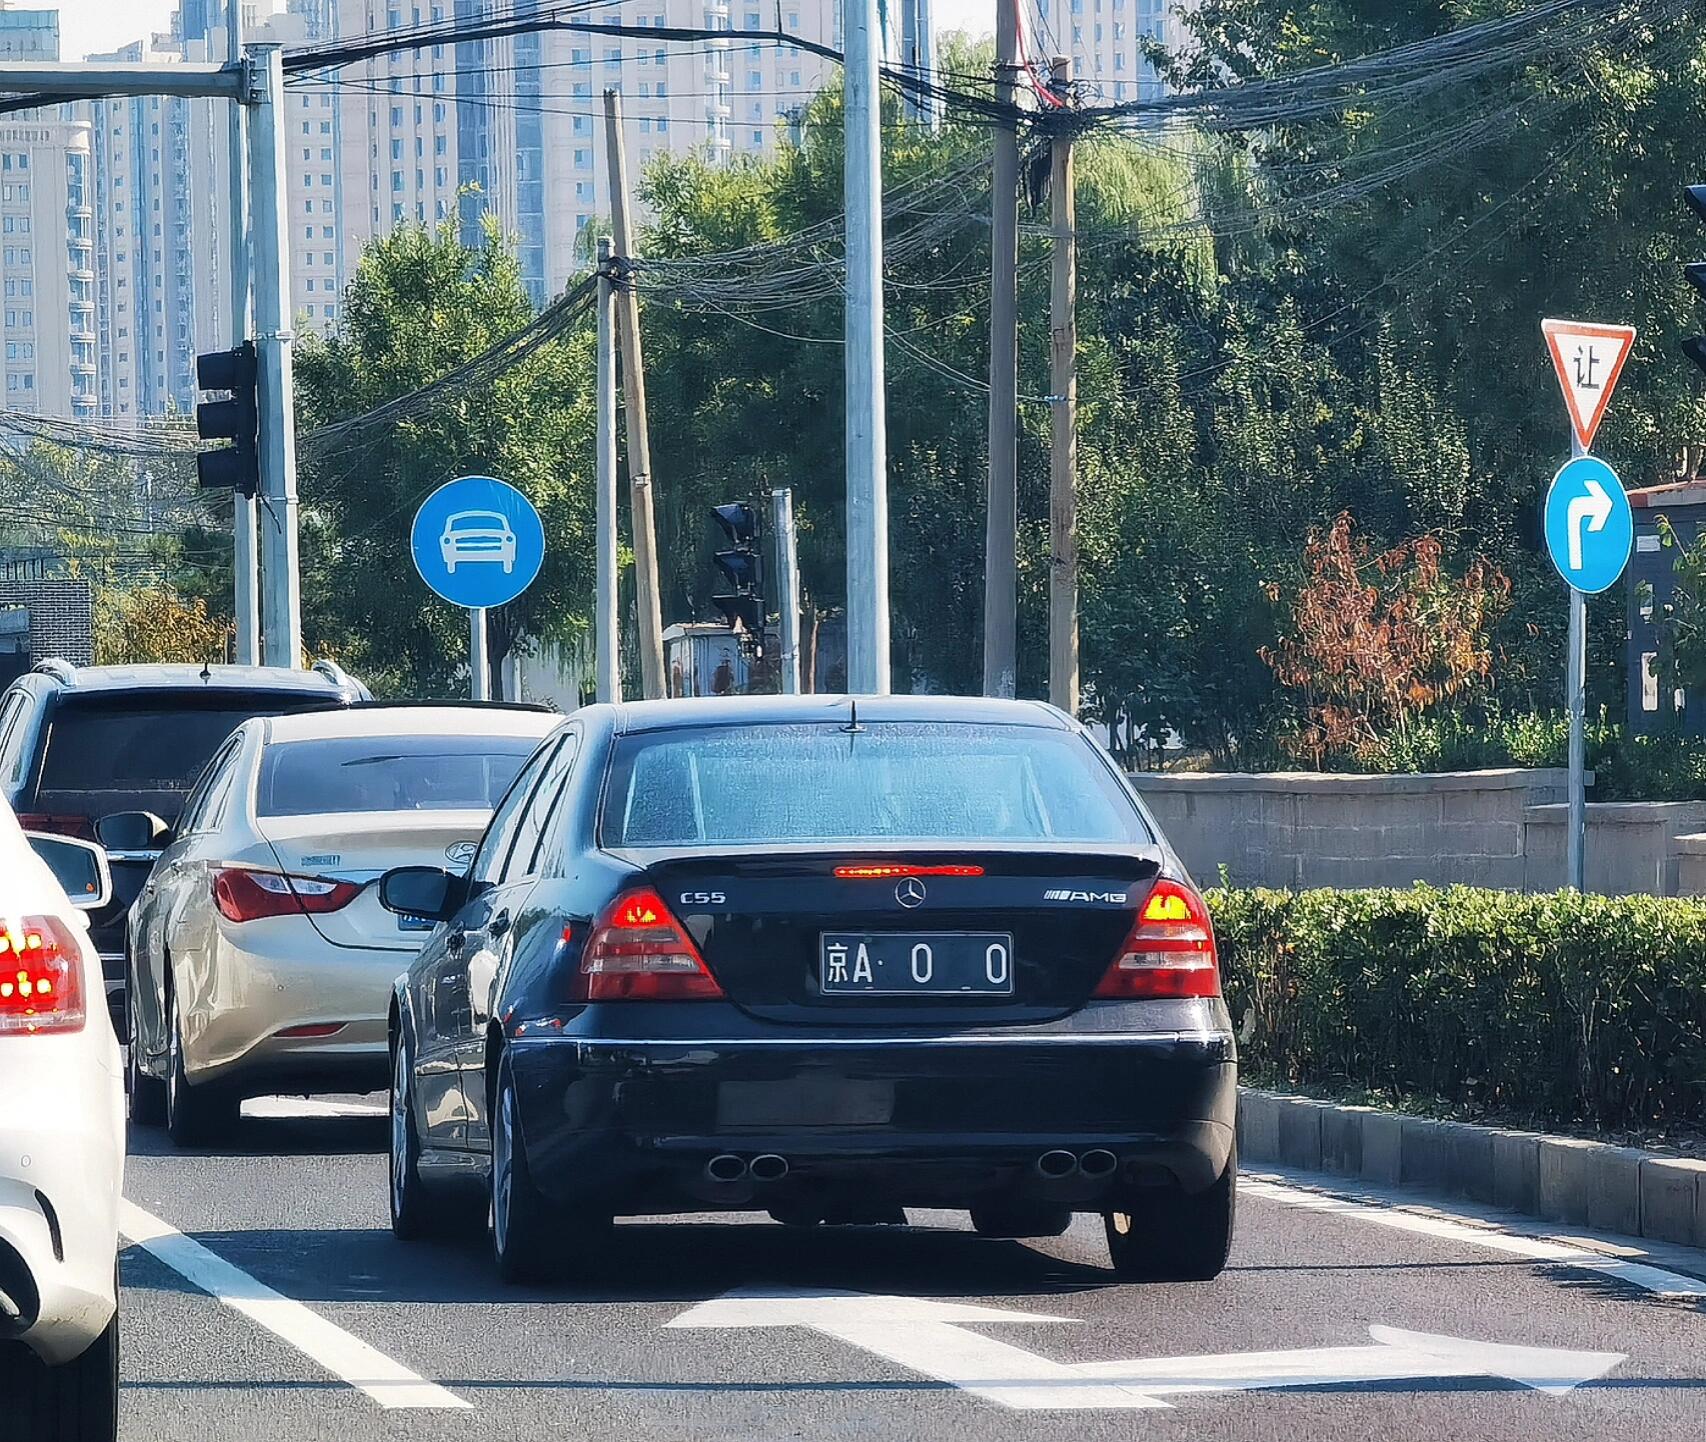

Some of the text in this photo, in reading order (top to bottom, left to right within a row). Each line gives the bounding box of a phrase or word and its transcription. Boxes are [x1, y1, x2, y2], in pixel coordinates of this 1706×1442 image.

[1573, 345, 1600, 390] 让
[680, 892, 726, 904] C55
[1069, 891, 1127, 903] AMG
